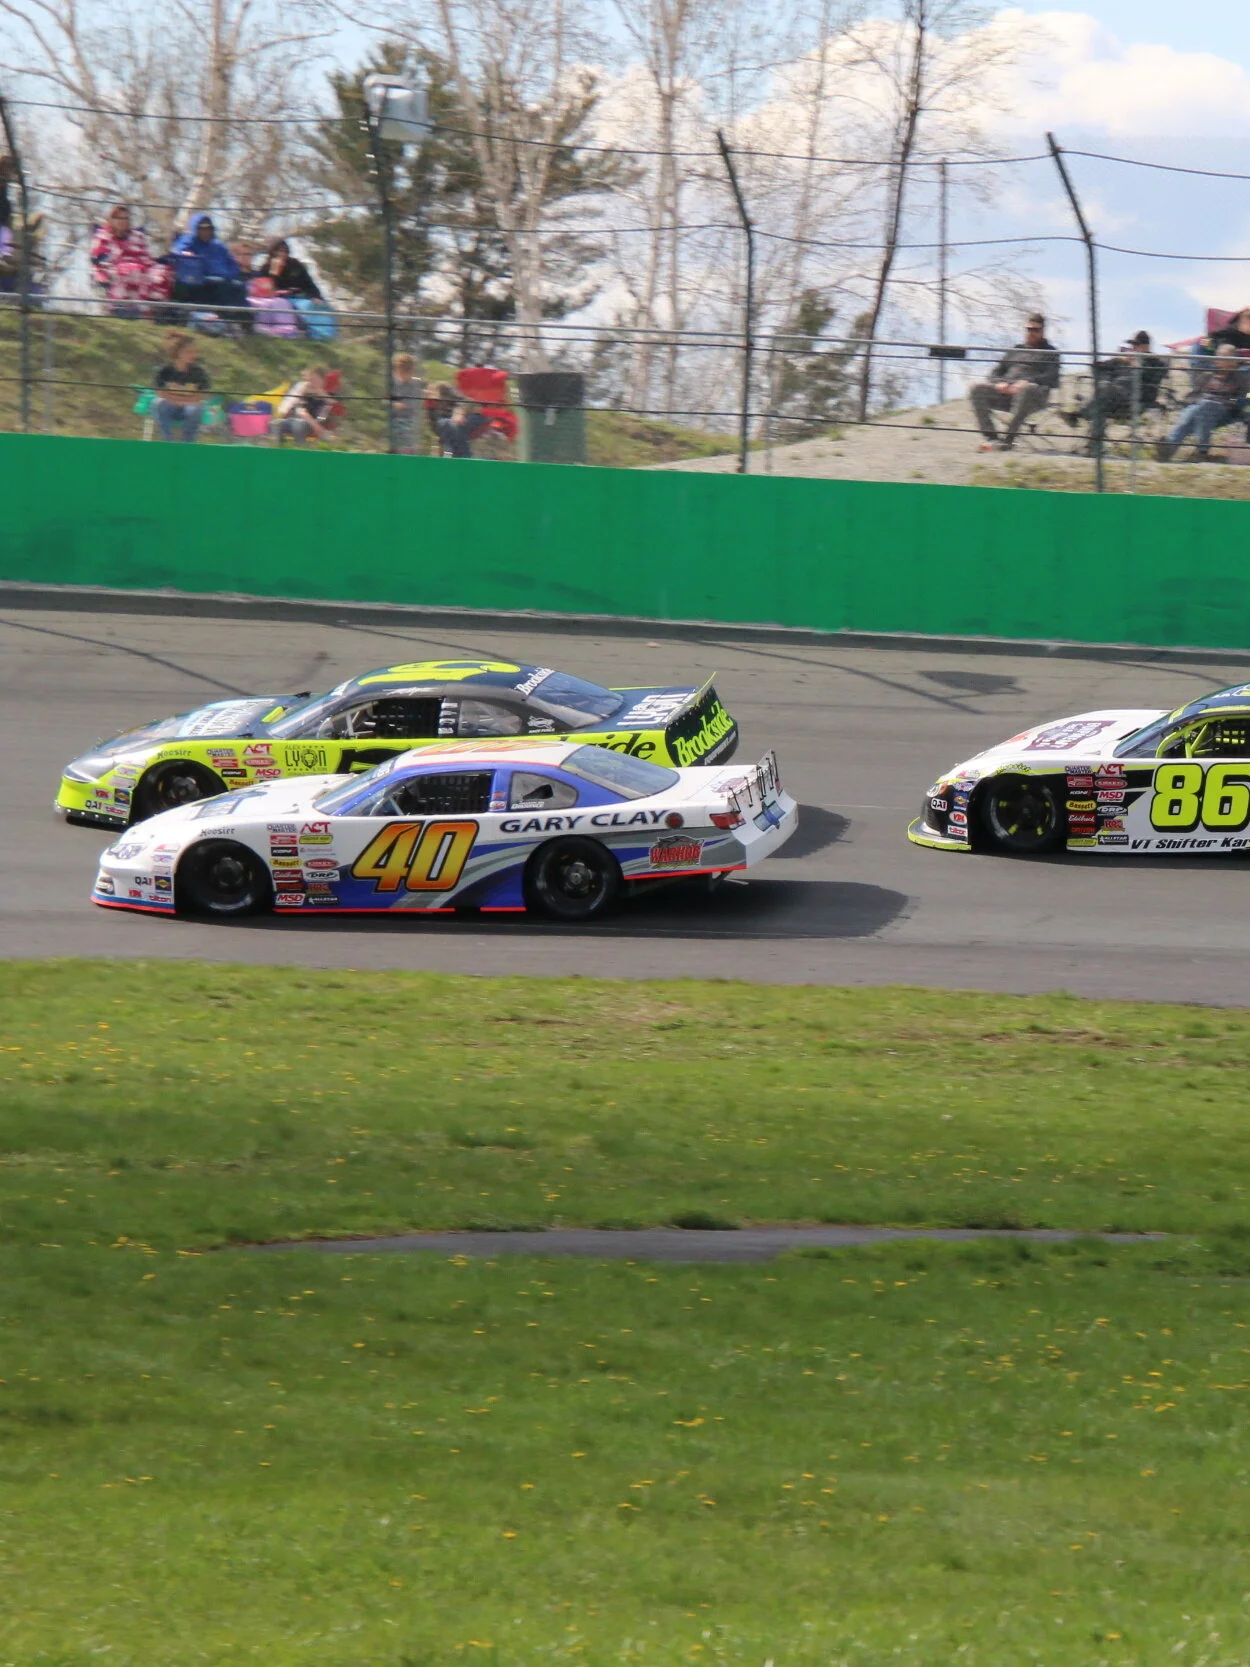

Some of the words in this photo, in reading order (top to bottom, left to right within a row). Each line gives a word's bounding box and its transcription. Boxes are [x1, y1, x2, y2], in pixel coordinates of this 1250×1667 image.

[672, 700, 734, 767] Brookside
[243, 743, 272, 756] ACT
[255, 769, 280, 777] MSD
[1097, 763, 1125, 774] ACT
[1099, 791, 1123, 799] MSD
[932, 799, 947, 809] QA1
[499, 815, 584, 833] GARY
[591, 809, 668, 827] CLAY
[301, 822, 331, 832] ACT
[1131, 840, 1151, 849] VT
[1156, 838, 1218, 849] Shifter
[351, 820, 479, 892] 40
[278, 894, 303, 902] MSD
